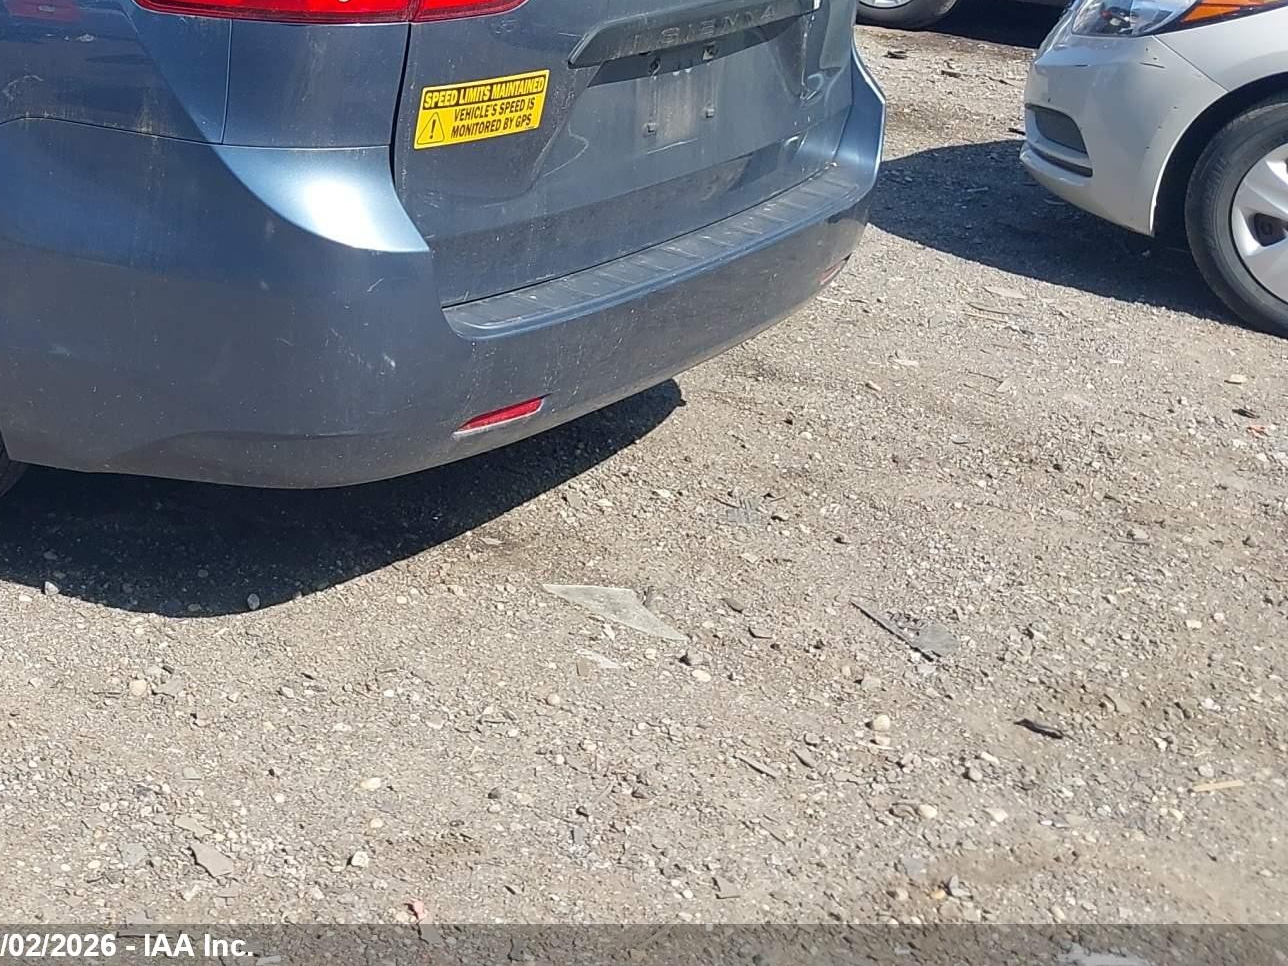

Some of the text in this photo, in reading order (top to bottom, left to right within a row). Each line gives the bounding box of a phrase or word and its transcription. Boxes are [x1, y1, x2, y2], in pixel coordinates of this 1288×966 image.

[423, 76, 545, 108] SPEED LIMITS MAINTAINED
[454, 96, 535, 122] VEHICLE'S SPEED IS
[450, 113, 532, 138] MONITORED BY GPS
